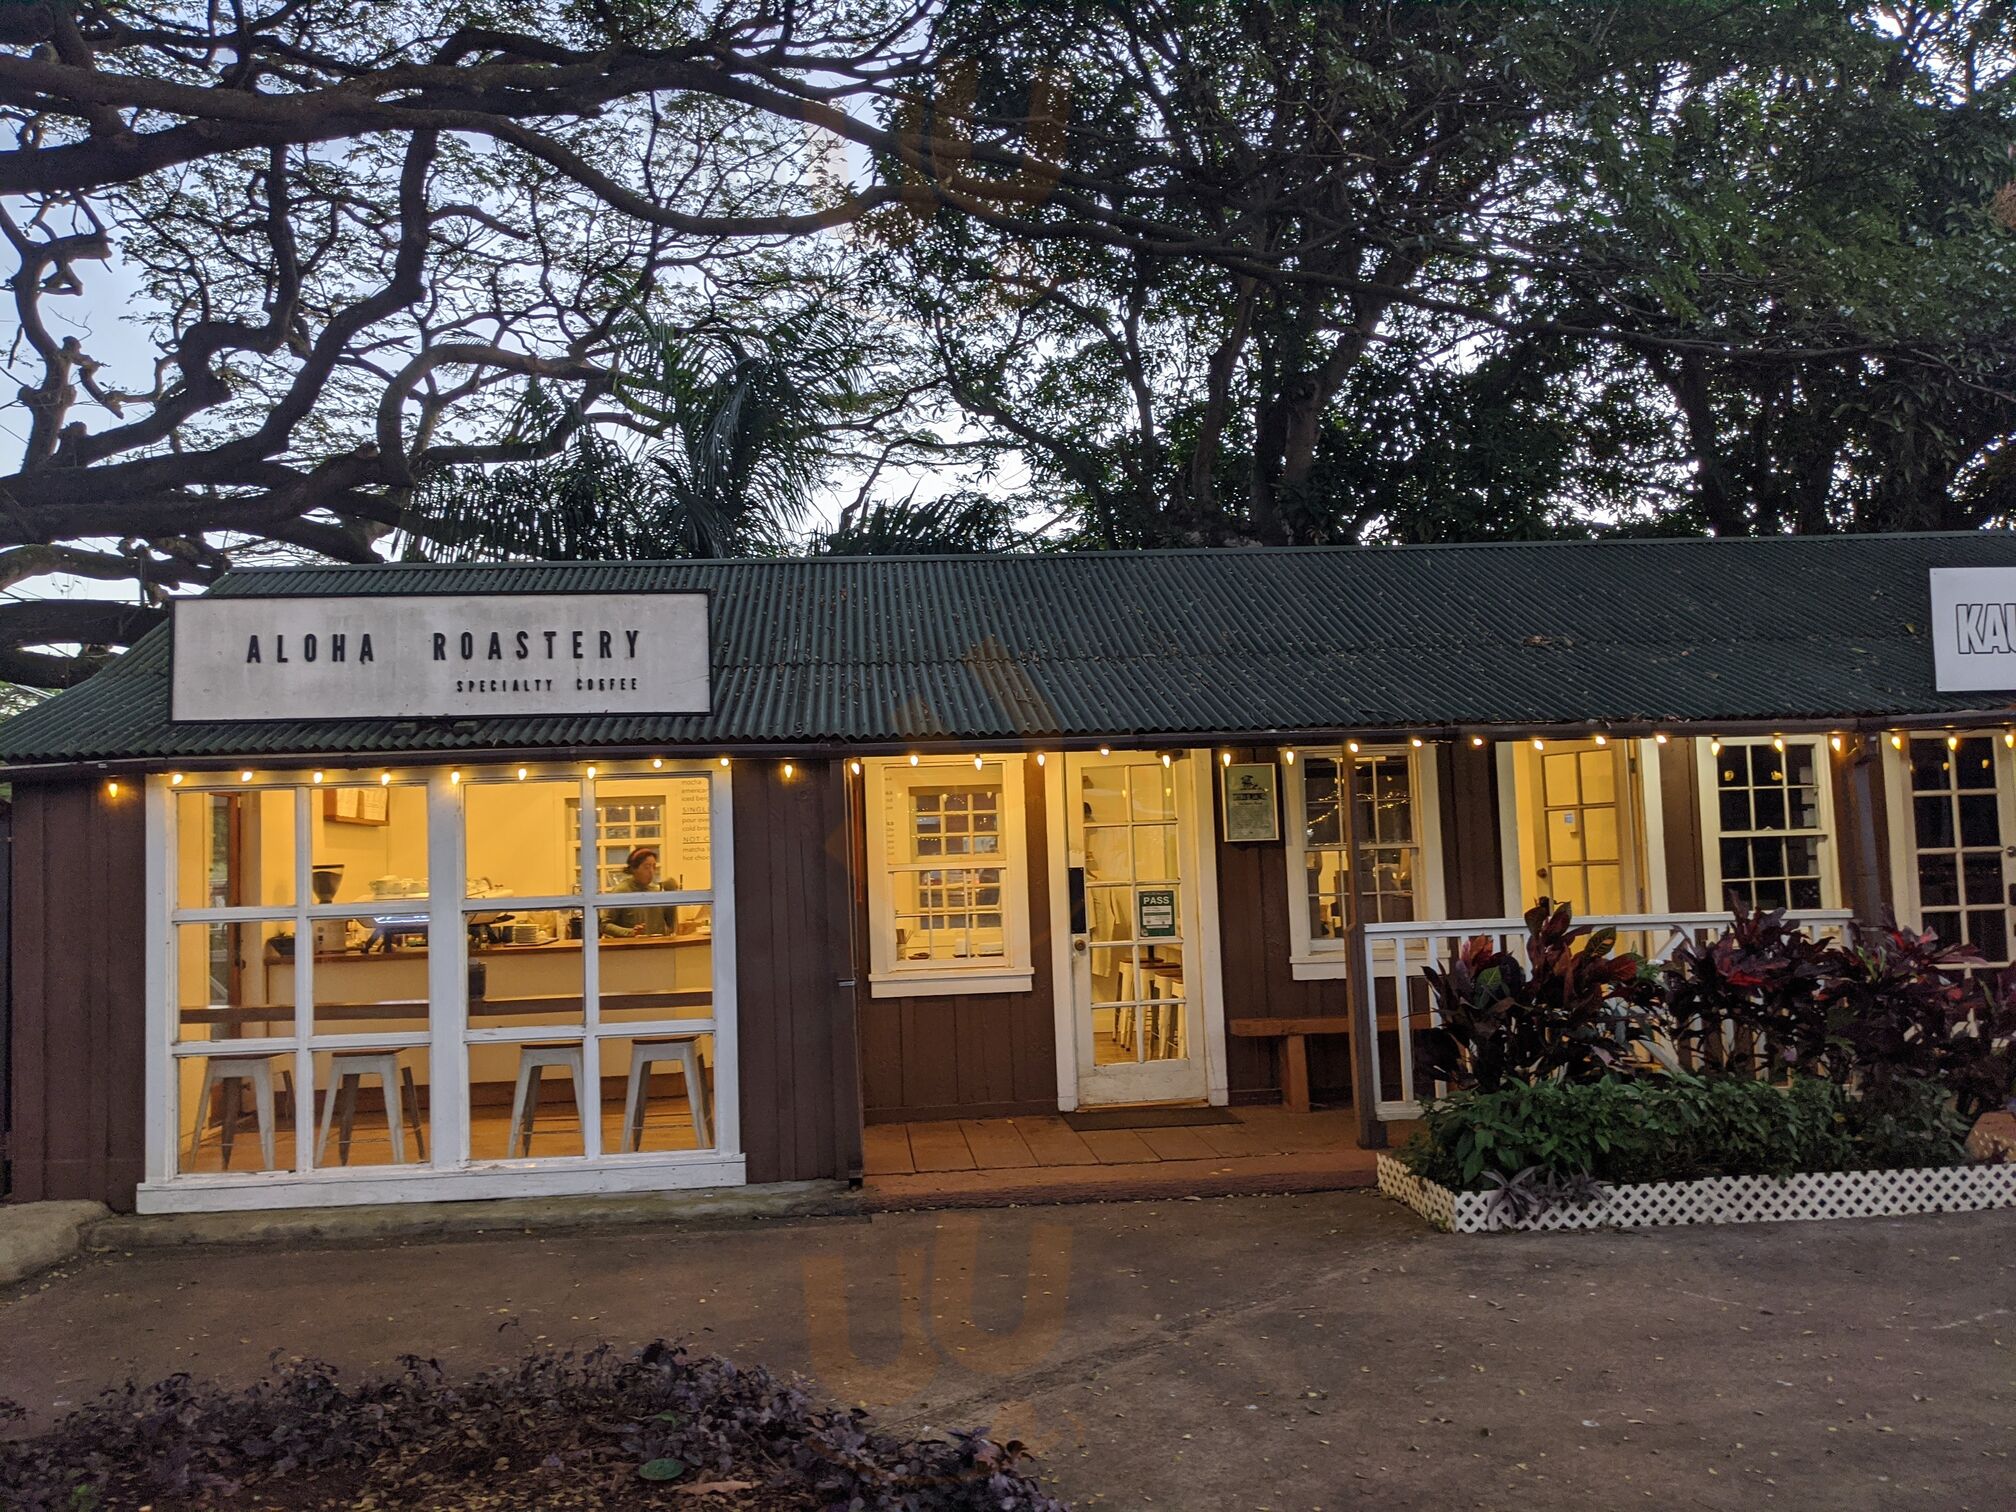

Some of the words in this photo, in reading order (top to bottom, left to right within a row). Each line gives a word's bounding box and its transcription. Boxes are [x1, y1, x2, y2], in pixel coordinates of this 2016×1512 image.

[246, 633, 374, 664] ALOHA
[433, 630, 639, 661] ROASTERY
[456, 679, 552, 693] SPECIALTY
[576, 677, 637, 692] COFFEE
[1143, 896, 1170, 904] PASS
